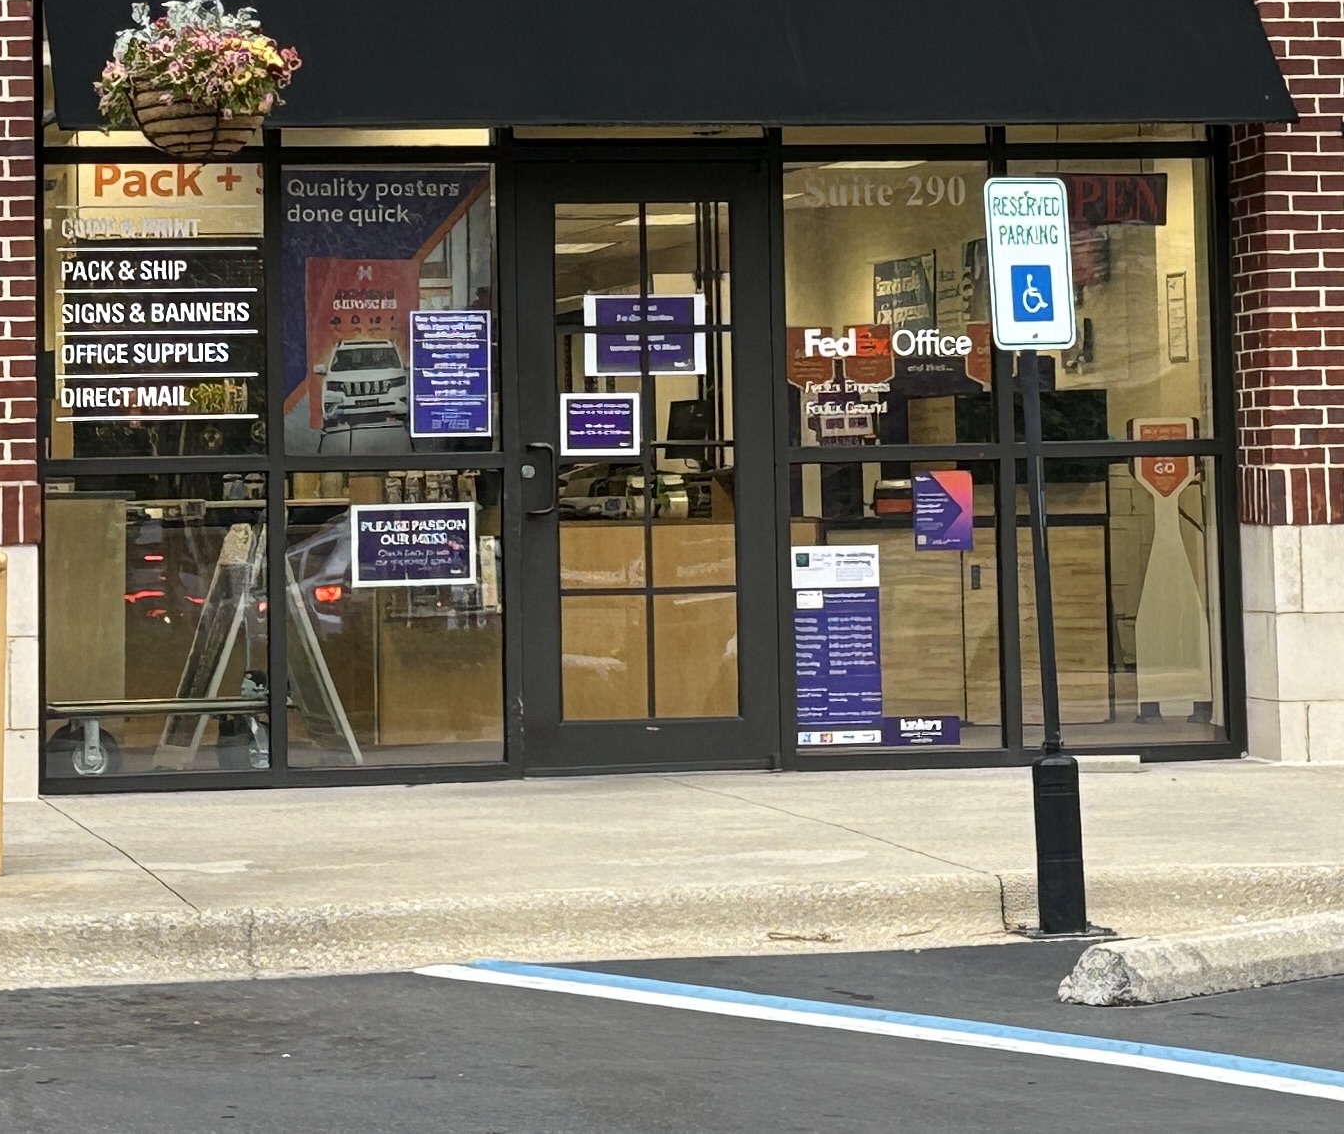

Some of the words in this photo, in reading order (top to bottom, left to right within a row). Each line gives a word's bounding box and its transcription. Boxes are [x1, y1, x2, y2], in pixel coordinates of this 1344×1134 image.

[94, 163, 204, 197] Pack
[287, 178, 369, 201] Quality
[375, 179, 460, 201] posters
[805, 172, 893, 207] Suite
[906, 175, 967, 207] 290
[993, 196, 1060, 216] RESERVED
[1068, 176, 1157, 221] PEN
[287, 204, 343, 222] done
[349, 203, 411, 227] quick
[999, 224, 1058, 245] PARKING
[61, 260, 114, 281] PACK
[118, 260, 136, 280] &
[139, 259, 188, 281] SHIP
[61, 302, 125, 324] SIGNS
[129, 302, 146, 323] &
[151, 302, 250, 322] BANNERS
[61, 343, 129, 364] OFFICE
[133, 342, 230, 363] SUPPLIES
[804, 327, 891, 358] FedEx
[892, 328, 973, 357] Office
[61, 387, 133, 408] DIRECT
[137, 385, 191, 407] MAIL
[1154, 462, 1175, 474] GO
[380, 533, 410, 545] OUR
